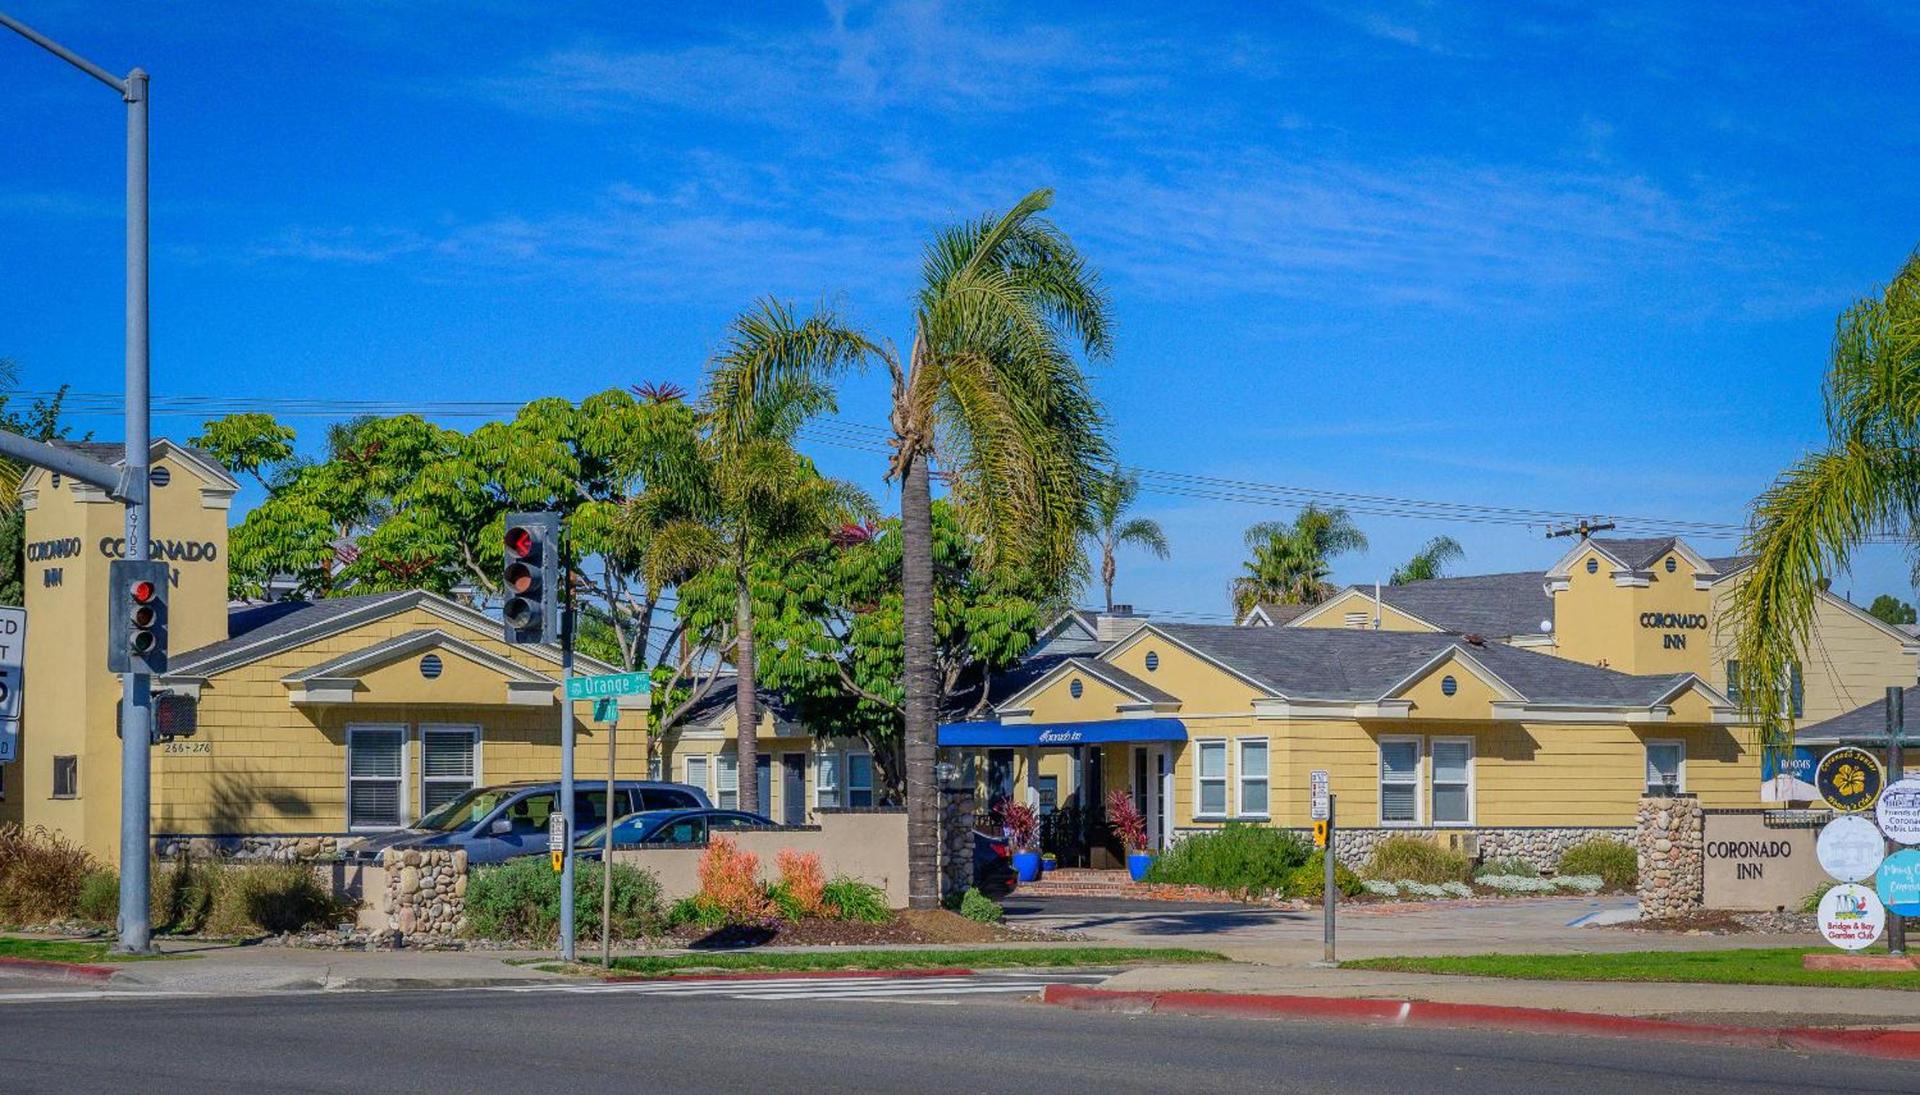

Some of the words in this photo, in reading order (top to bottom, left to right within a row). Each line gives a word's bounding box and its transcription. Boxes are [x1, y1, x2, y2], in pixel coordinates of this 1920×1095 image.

[27, 537, 81, 562] CORONADO
[100, 537, 217, 562] COONADO
[43, 568, 63, 588] INN
[1640, 613, 1707, 630] CORONADO
[1664, 634, 1686, 650] INN
[585, 677, 629, 695] Orange
[1781, 759, 1811, 769] ROOMS
[1707, 841, 1791, 858] CORONADO
[1737, 863, 1763, 879] INN
[1828, 922, 1851, 932] Bridge
[1861, 922, 1875, 933] Bay
[1829, 931, 1855, 939] Garden
[1857, 930, 1874, 939] Club
